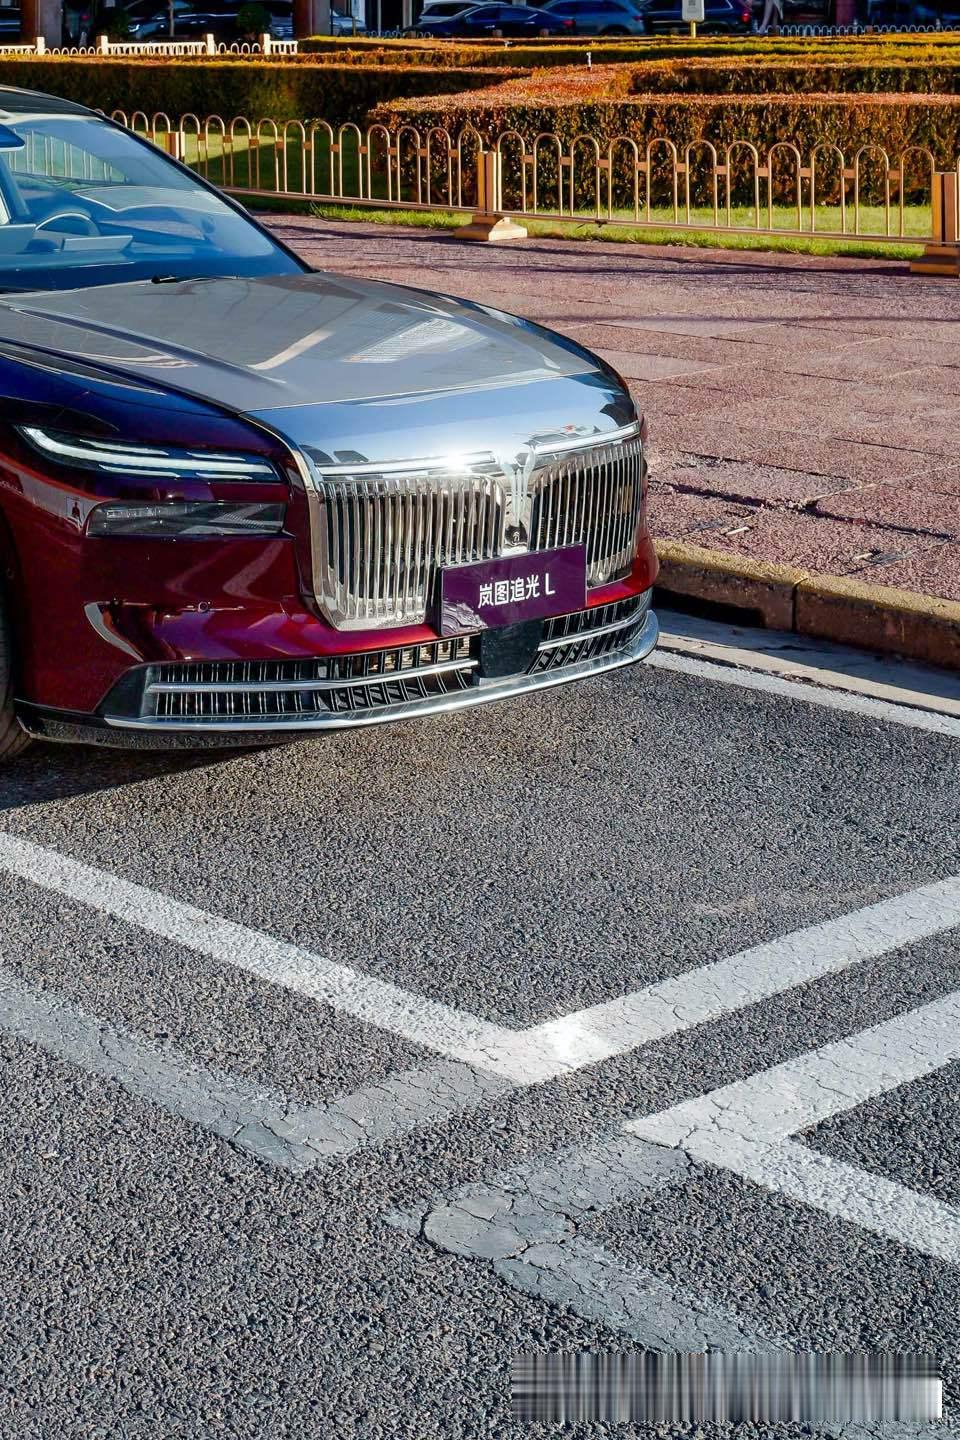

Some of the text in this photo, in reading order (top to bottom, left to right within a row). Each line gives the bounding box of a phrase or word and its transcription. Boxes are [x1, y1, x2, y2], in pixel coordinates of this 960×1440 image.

[478, 572, 556, 608] 岚图追光 L
